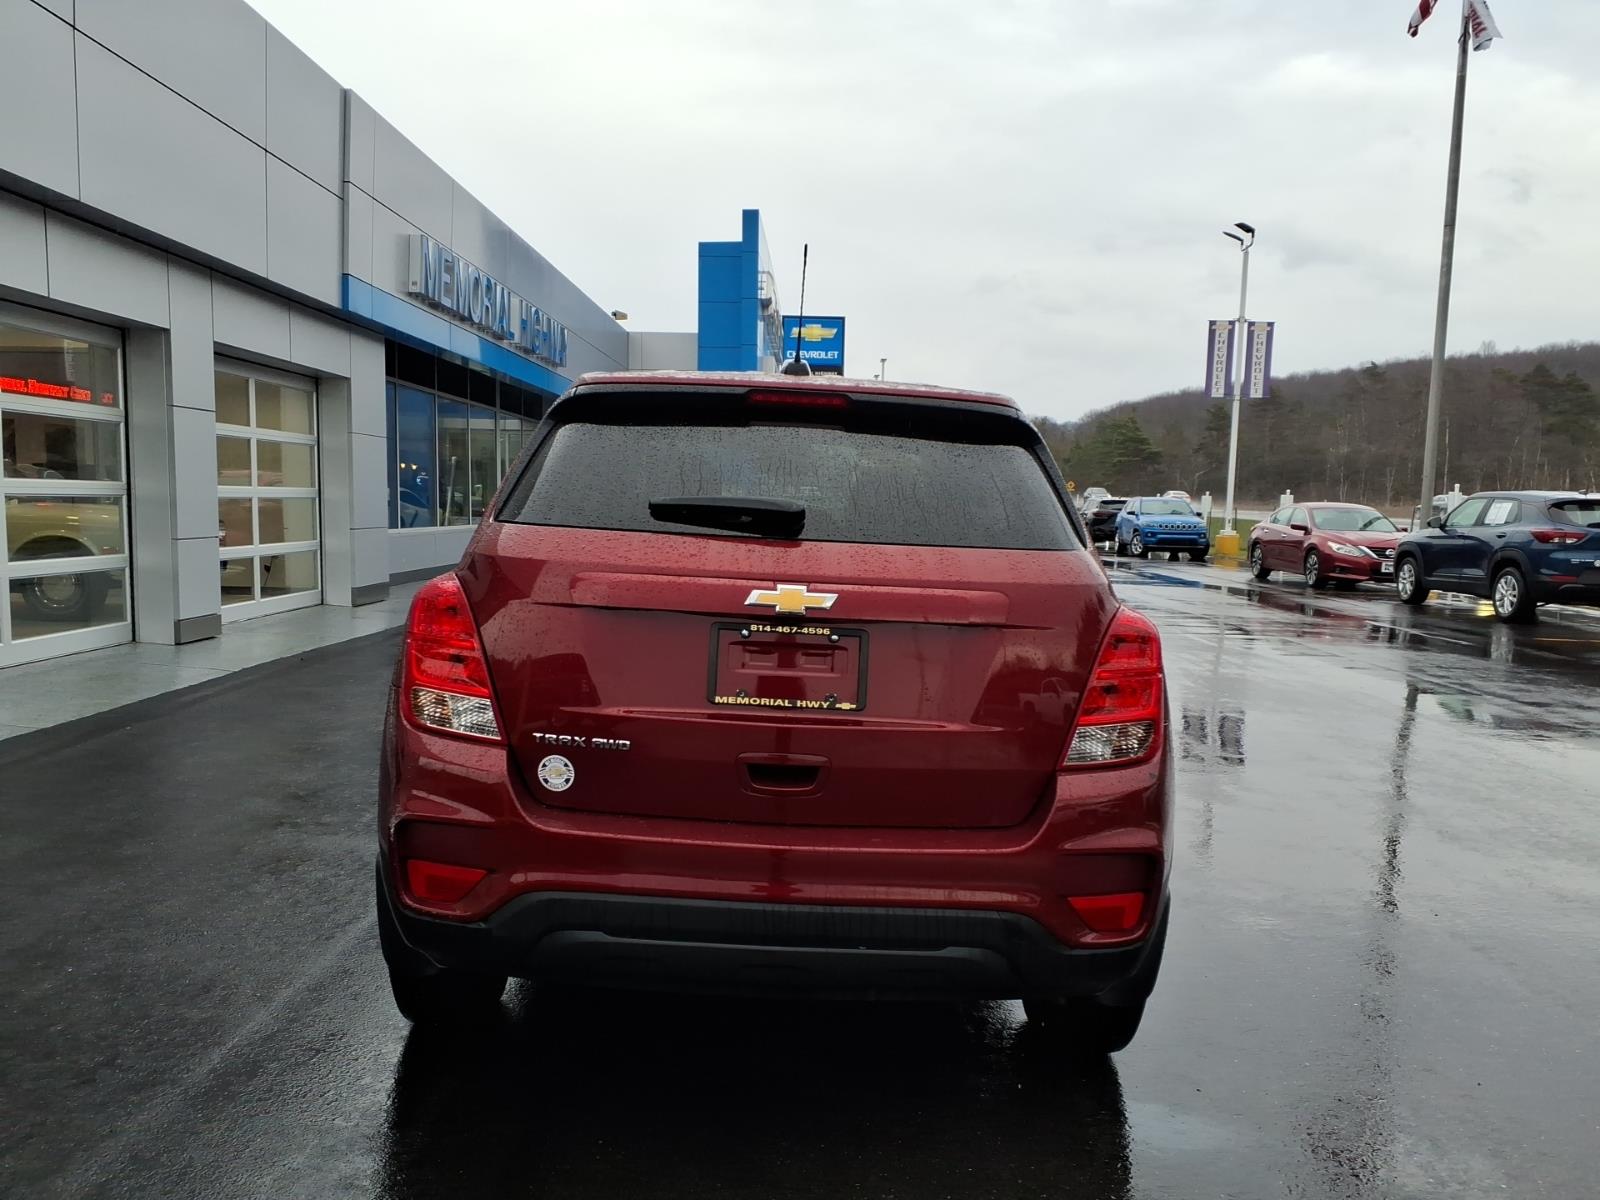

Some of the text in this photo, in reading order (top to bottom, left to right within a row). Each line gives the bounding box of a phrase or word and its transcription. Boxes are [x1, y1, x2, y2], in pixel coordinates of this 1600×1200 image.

[421, 235, 515, 340] MEMORIAL
[1215, 332, 1226, 393] CHEVROLET
[1254, 333, 1265, 394] CHEVROLET
[750, 624, 831, 636] 814-467-4596
[714, 696, 831, 709] MEMORIAL HWY
[532, 732, 631, 751] TRAX AWD
